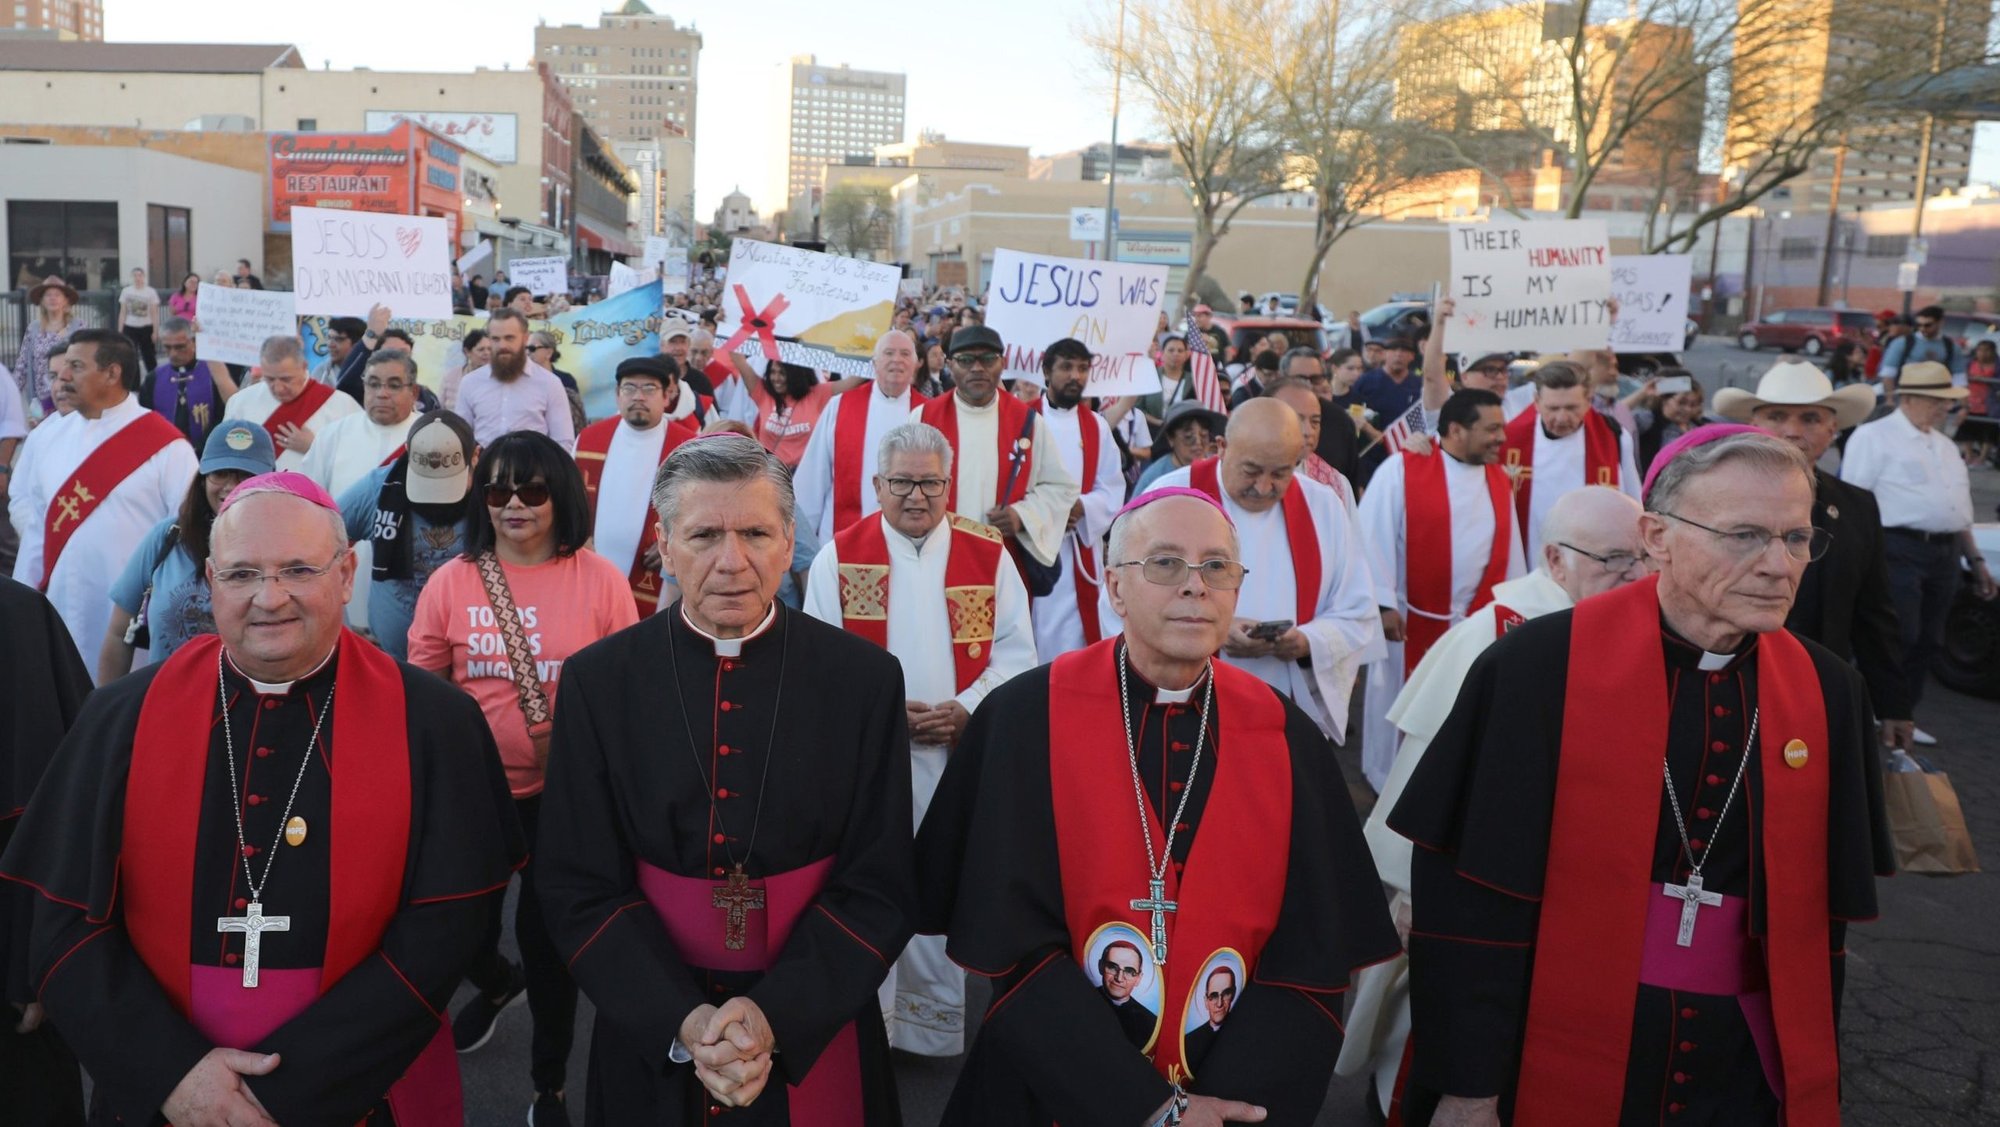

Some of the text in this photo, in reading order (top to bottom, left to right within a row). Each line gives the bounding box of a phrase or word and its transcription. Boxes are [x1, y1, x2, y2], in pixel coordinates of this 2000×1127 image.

[286, 174, 391, 192] RESTAURANT
[312, 219, 388, 259] JESUS
[1459, 228, 1523, 250] THEIR
[1528, 245, 1605, 268] HUMANITY
[297, 266, 335, 300] OUR
[336, 269, 405, 297] MIGRANT
[1000, 262, 1102, 307] JESUS
[1119, 276, 1160, 306] WAS
[1461, 275, 1558, 297] IS MY
[1494, 299, 1608, 329] HUMANITY
[431, 319, 467, 341] del
[1070, 313, 1108, 345] AN
[1003, 343, 1144, 383] IMRANT
[466, 606, 537, 629] TOS
